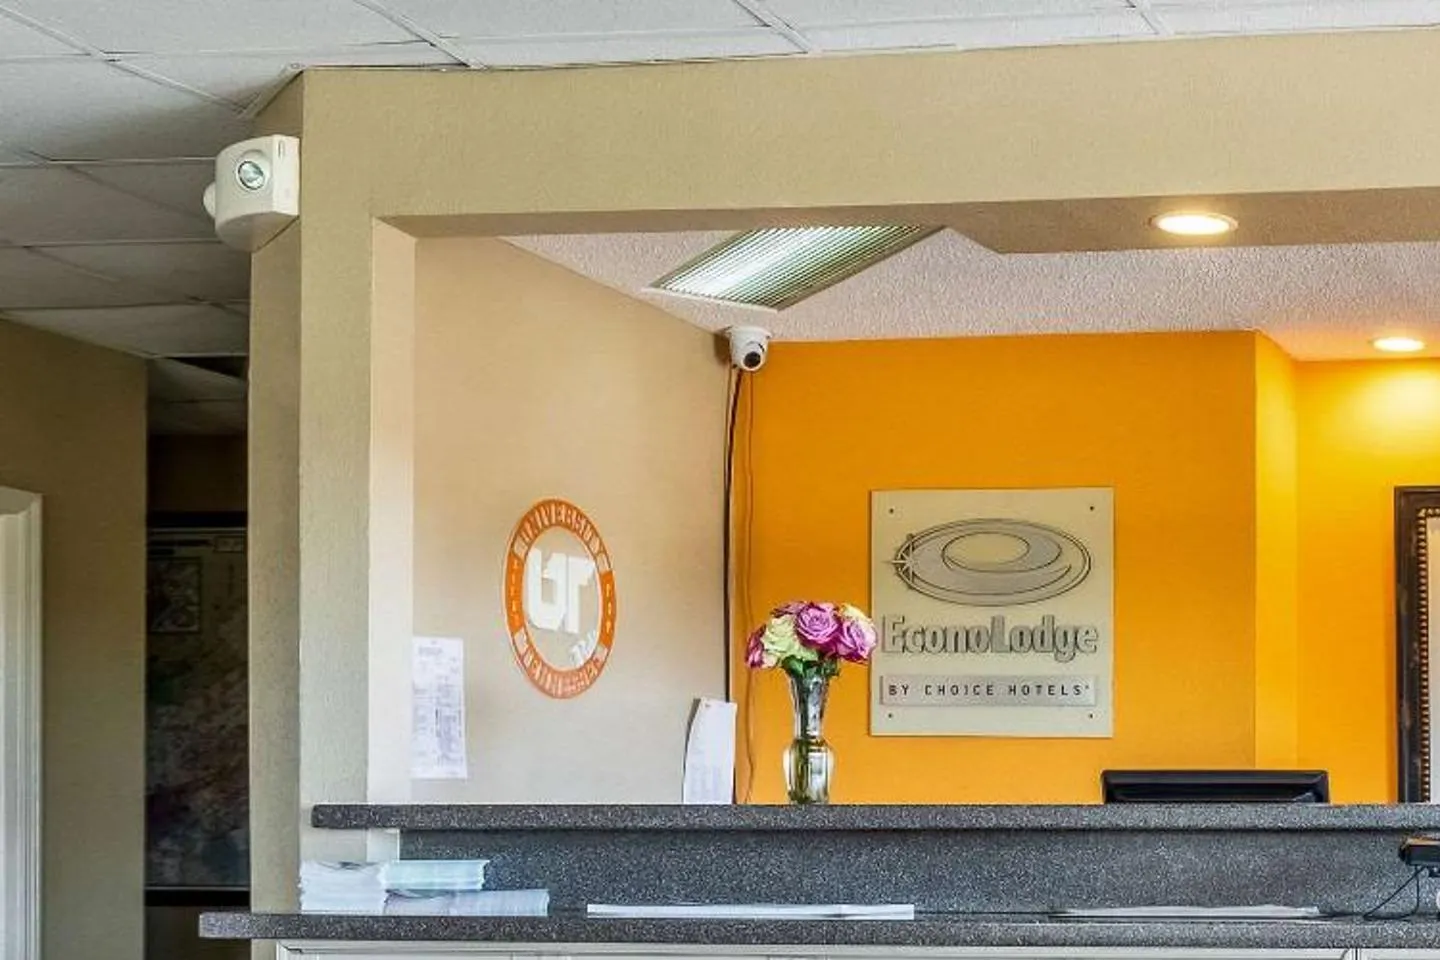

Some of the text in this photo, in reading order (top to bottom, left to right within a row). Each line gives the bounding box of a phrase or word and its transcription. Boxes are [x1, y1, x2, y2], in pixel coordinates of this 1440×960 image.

[527, 546, 596, 635] UT
[881, 614, 1099, 663] EconoLodge
[888, 683, 911, 697] BY
[923, 683, 996, 697] CHOICE
